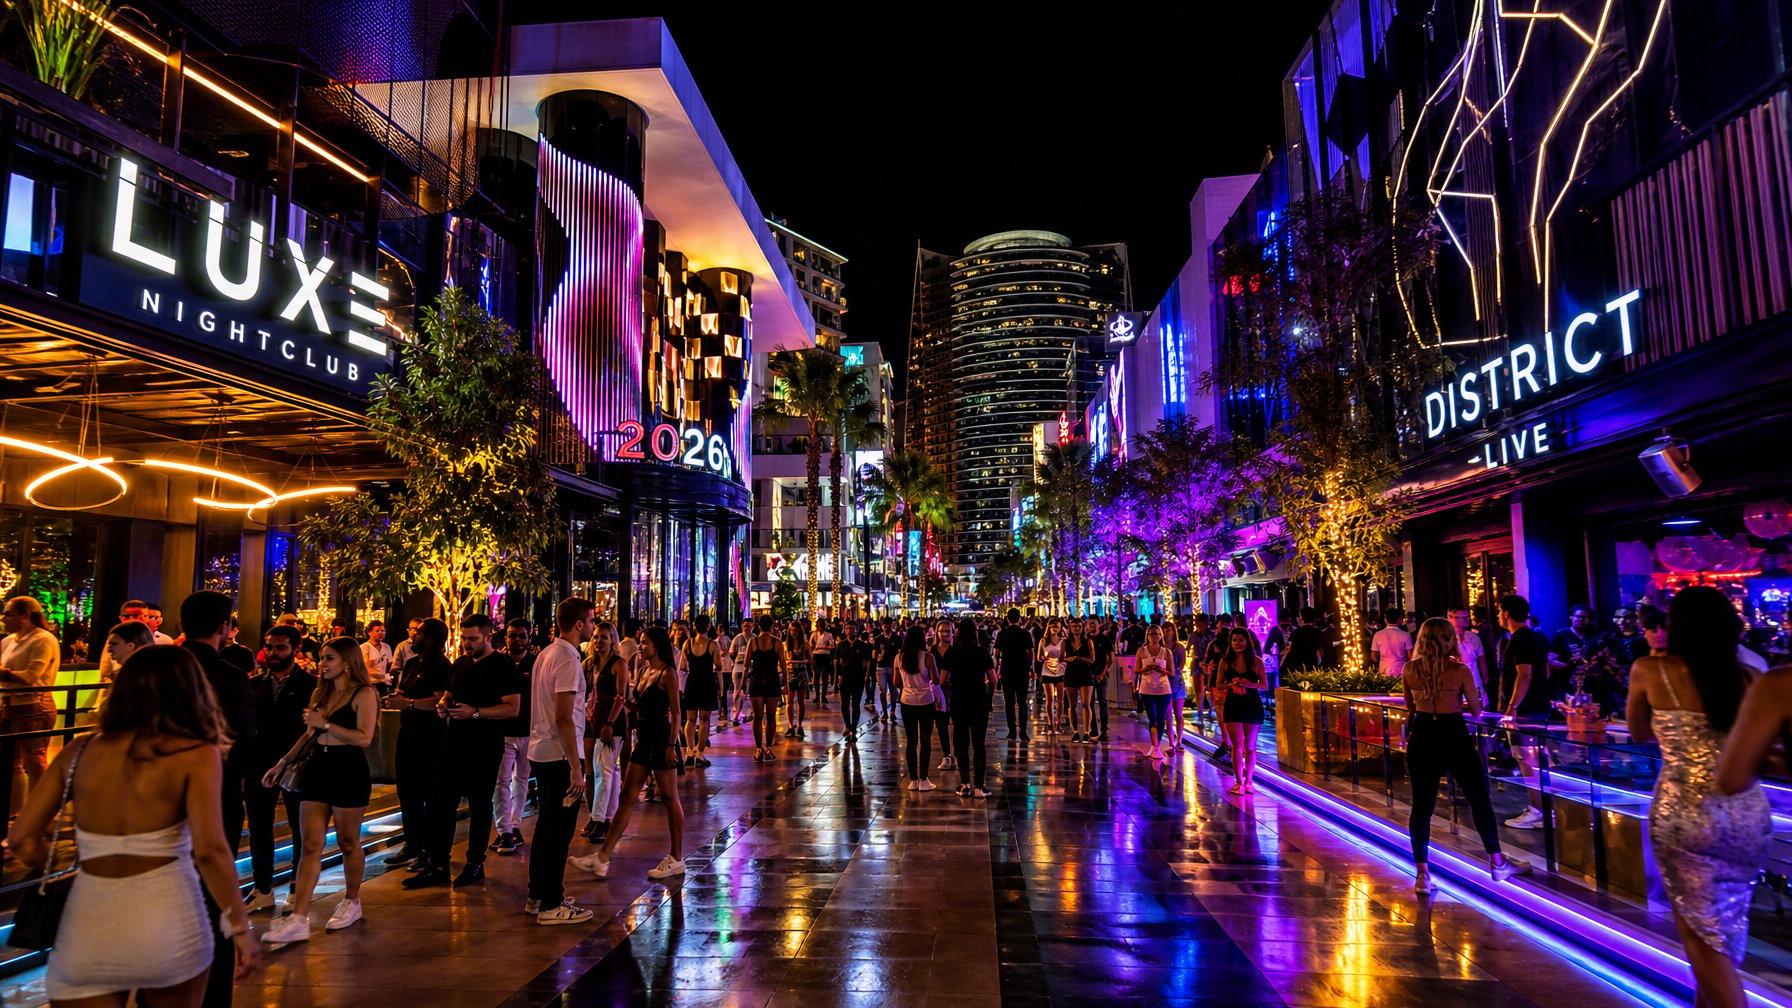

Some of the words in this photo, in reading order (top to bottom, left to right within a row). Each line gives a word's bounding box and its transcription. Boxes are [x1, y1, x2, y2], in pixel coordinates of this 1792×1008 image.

[111, 156, 391, 357] LUXE
[142, 287, 359, 382] NIGHTCLUB
[1424, 288, 1641, 439] DISTRICT
[617, 420, 723, 471] 2026
